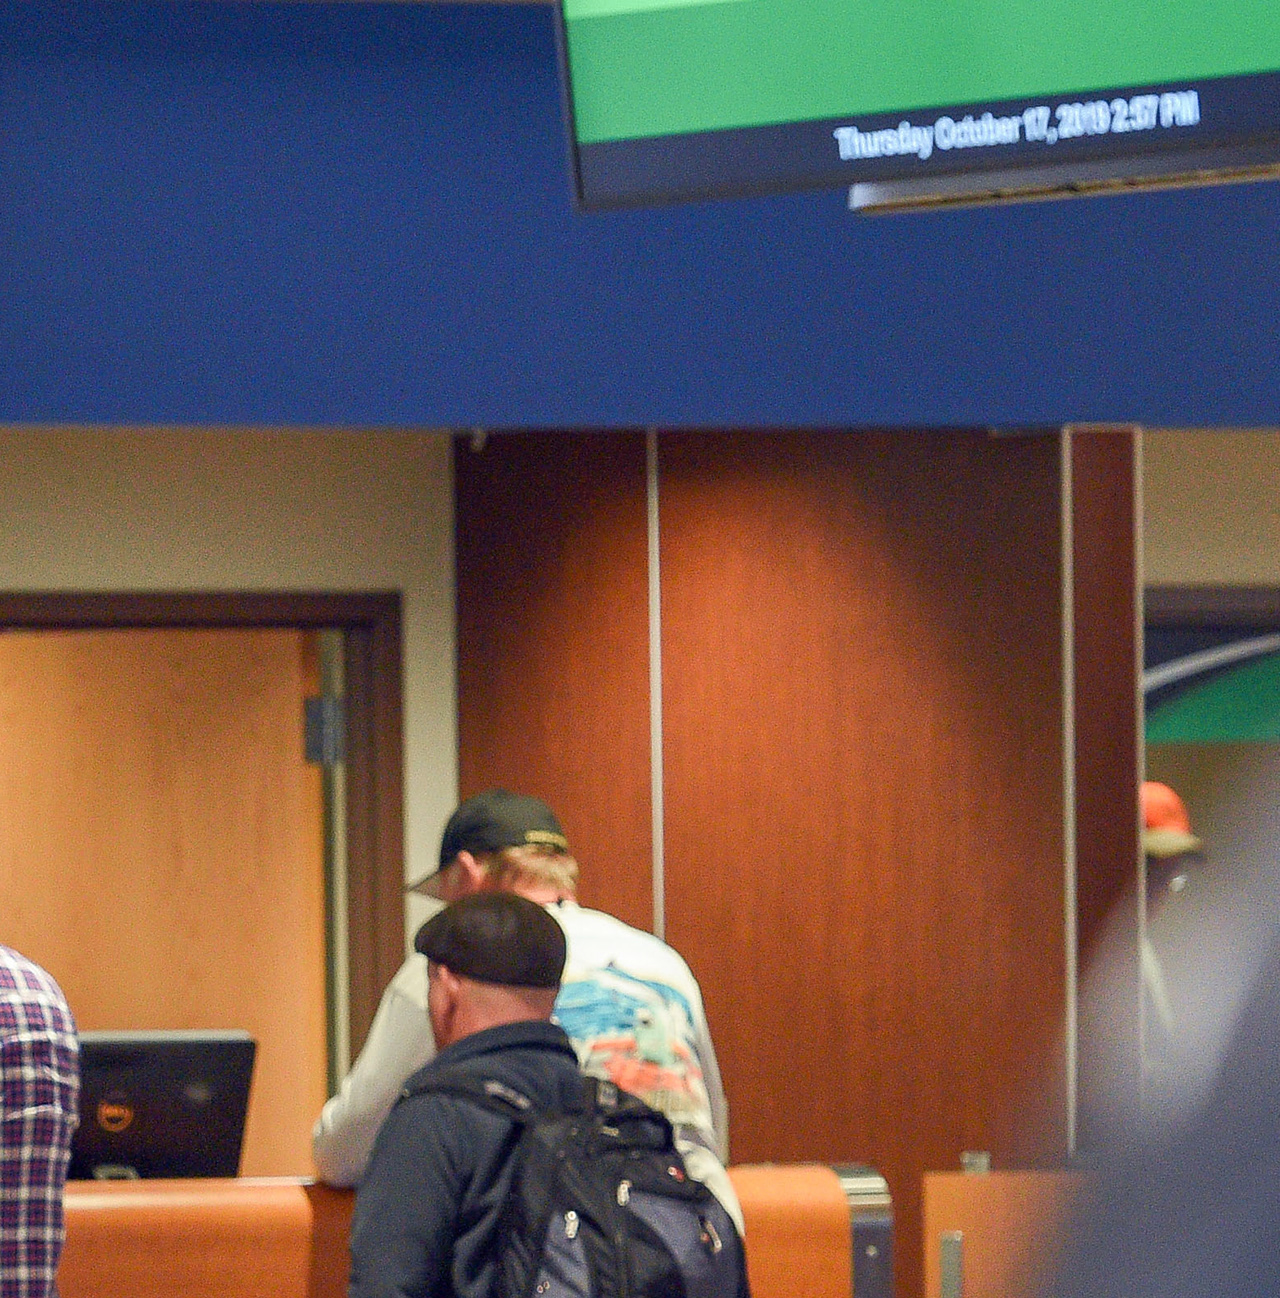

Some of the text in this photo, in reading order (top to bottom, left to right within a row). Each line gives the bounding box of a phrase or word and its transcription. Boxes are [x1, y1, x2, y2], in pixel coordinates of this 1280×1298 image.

[833, 120, 934, 160] Thursday
[934, 111, 1022, 150] October
[1159, 90, 1200, 128] PM
